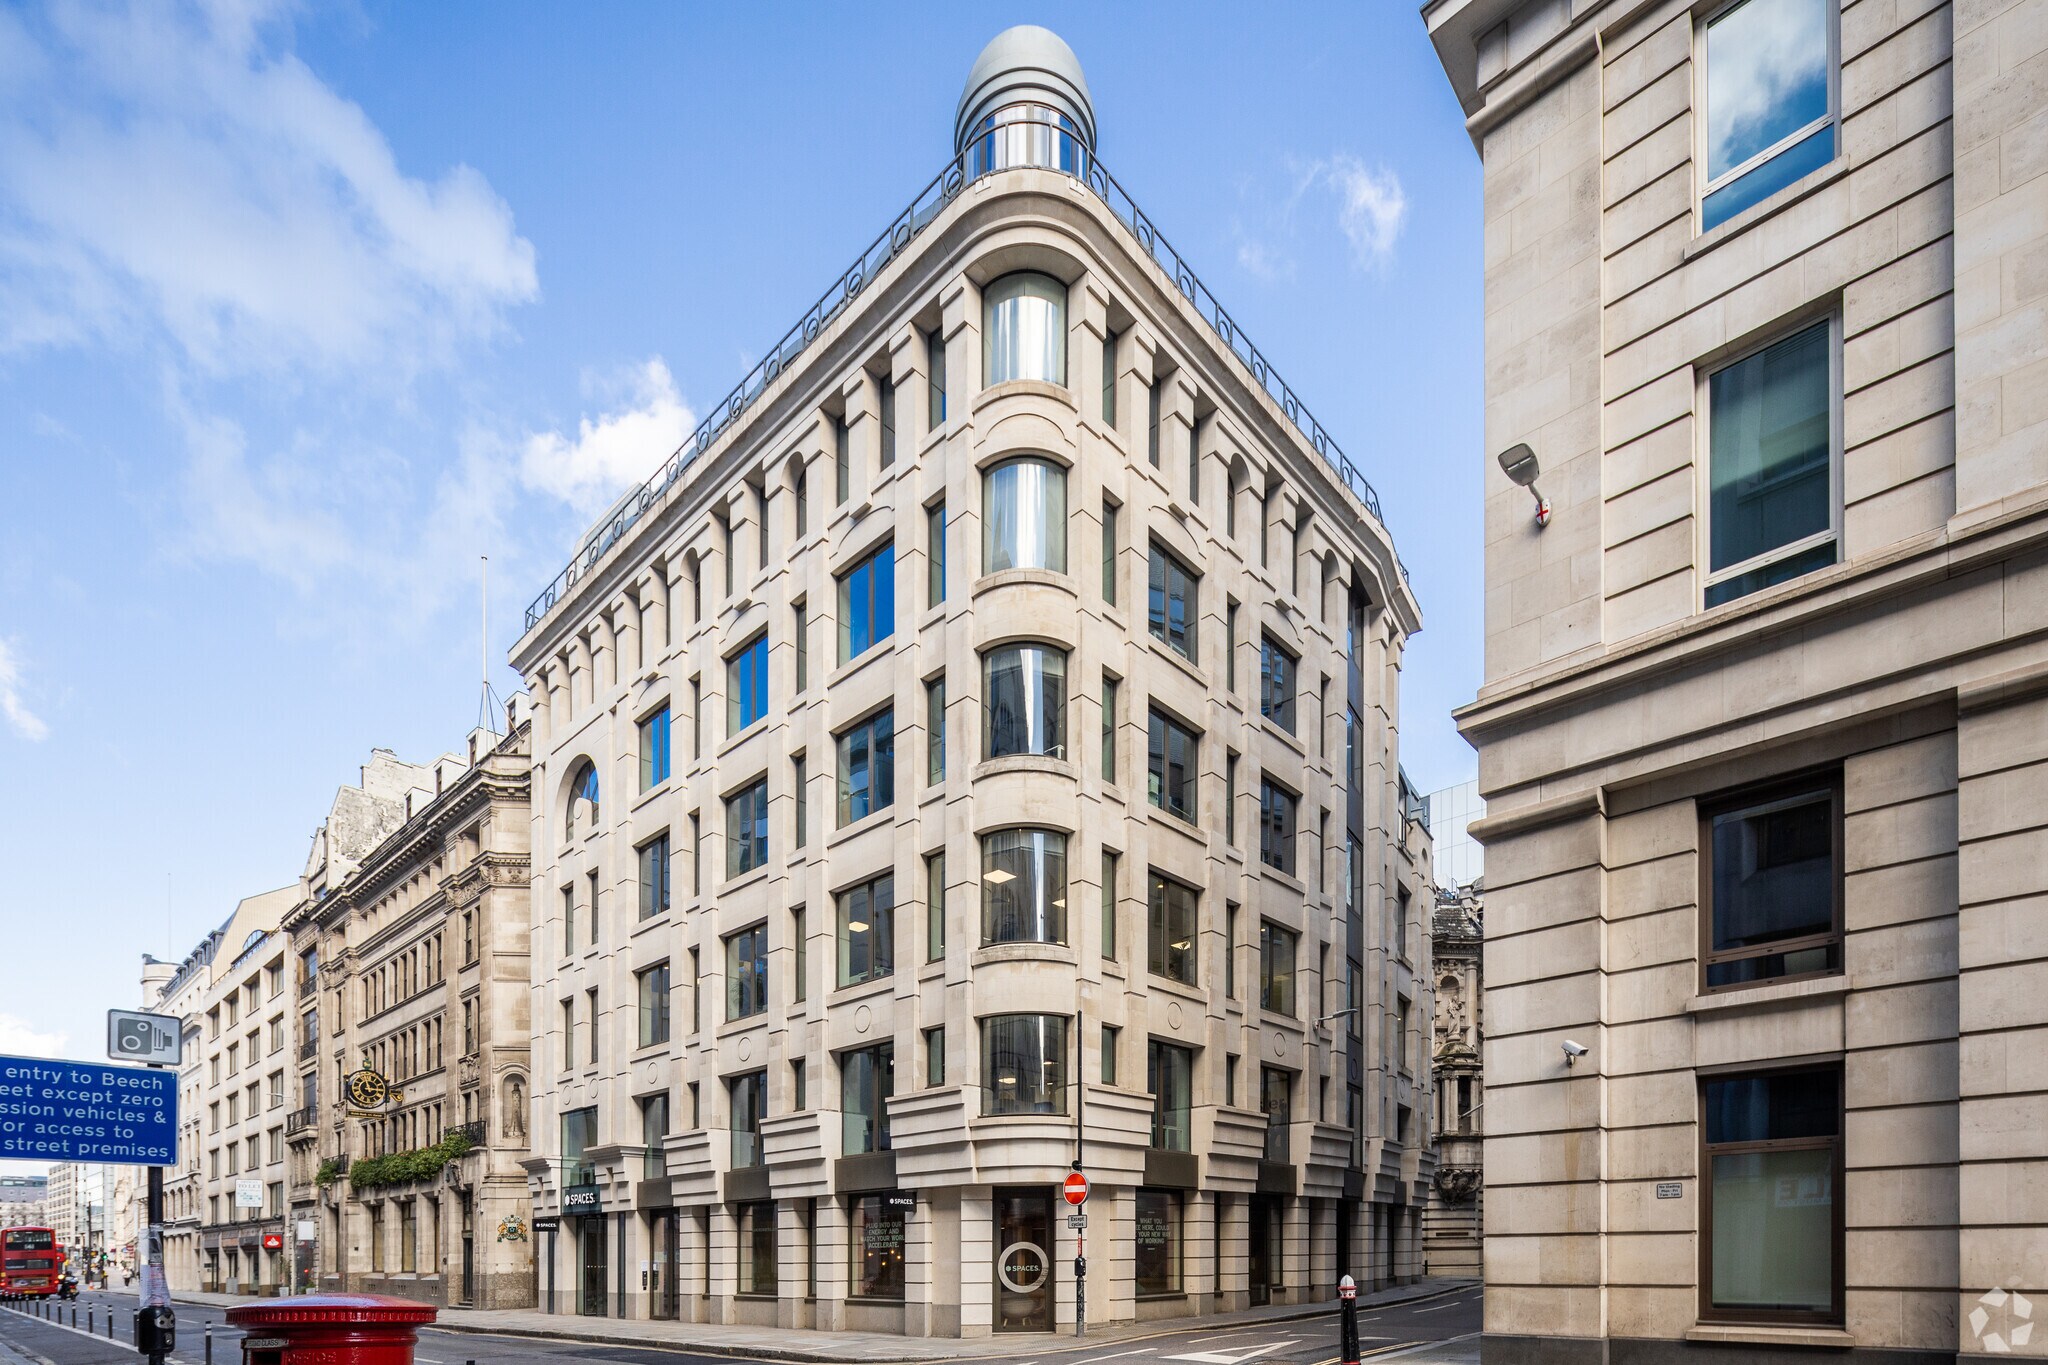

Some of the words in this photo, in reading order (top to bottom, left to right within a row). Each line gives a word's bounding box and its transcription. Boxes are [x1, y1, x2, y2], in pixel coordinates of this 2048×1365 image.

[6, 1066, 62, 1084] entry
[70, 1070, 92, 1084] to
[102, 1072, 163, 1090] Beech
[42, 1088, 113, 1104] except
[121, 1094, 163, 1107] zero
[64, 1106, 145, 1122] vehicles
[154, 1111, 166, 1124] &
[0, 1118, 25, 1132] or
[34, 1123, 105, 1137] access
[113, 1125, 134, 1139] to
[4, 1137, 70, 1152] street
[78, 1143, 168, 1157] premises
